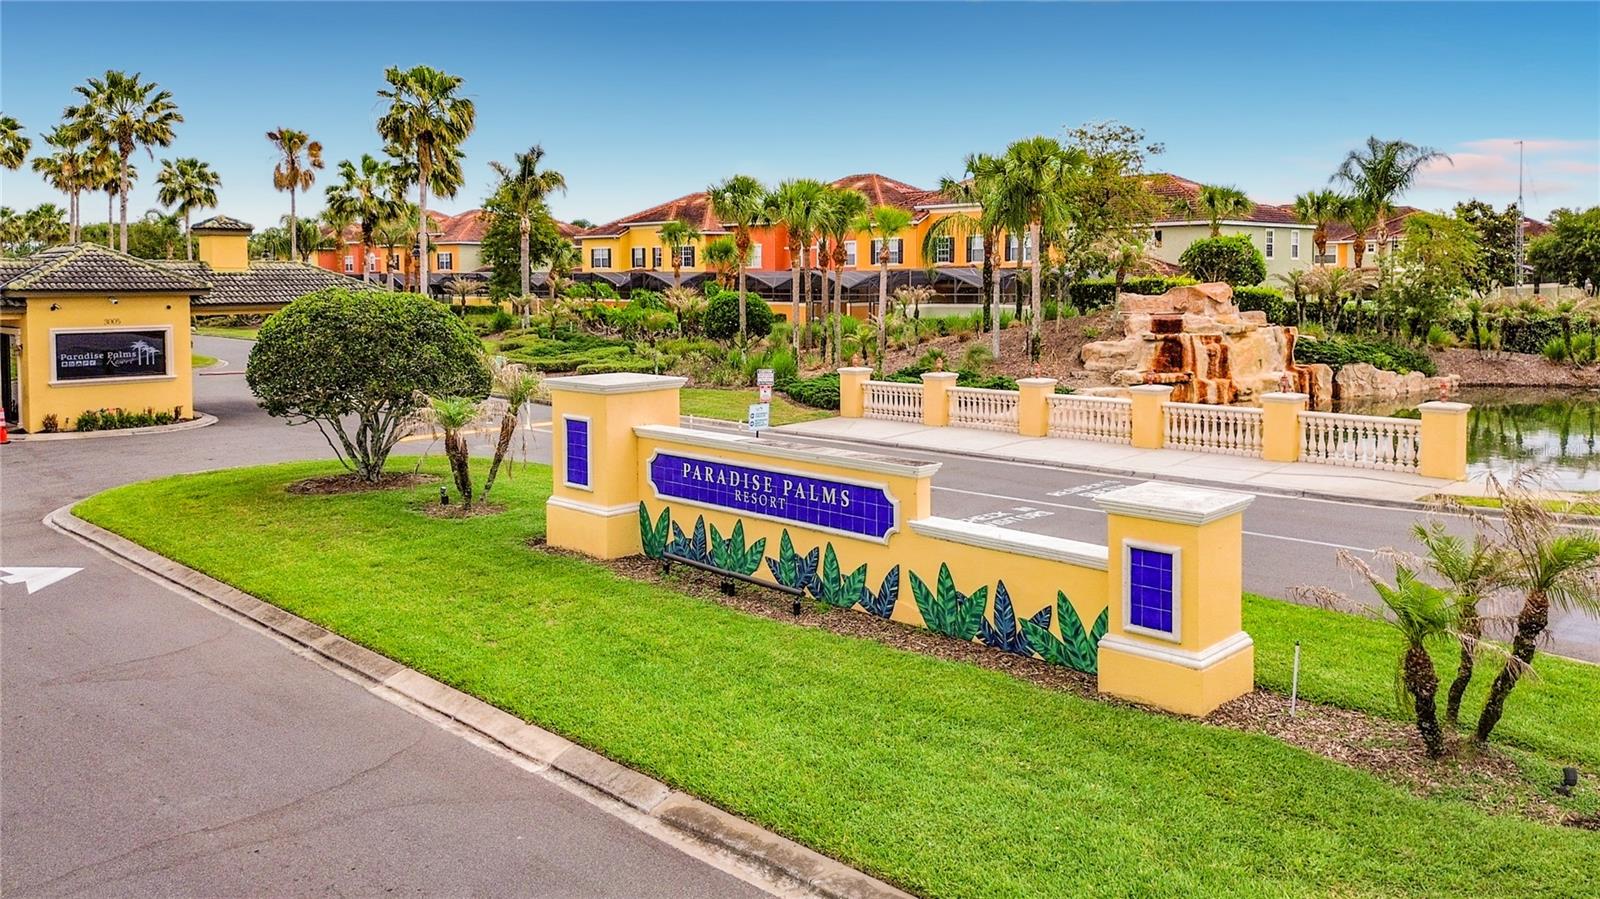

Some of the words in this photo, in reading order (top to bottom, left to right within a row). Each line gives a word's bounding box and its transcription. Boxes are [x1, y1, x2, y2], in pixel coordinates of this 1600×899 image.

[60, 352, 104, 360] Paradise
[107, 351, 137, 360] Palms
[682, 462, 773, 493] PARADISE
[783, 479, 850, 508] PALMS
[735, 489, 786, 510] RESORT
